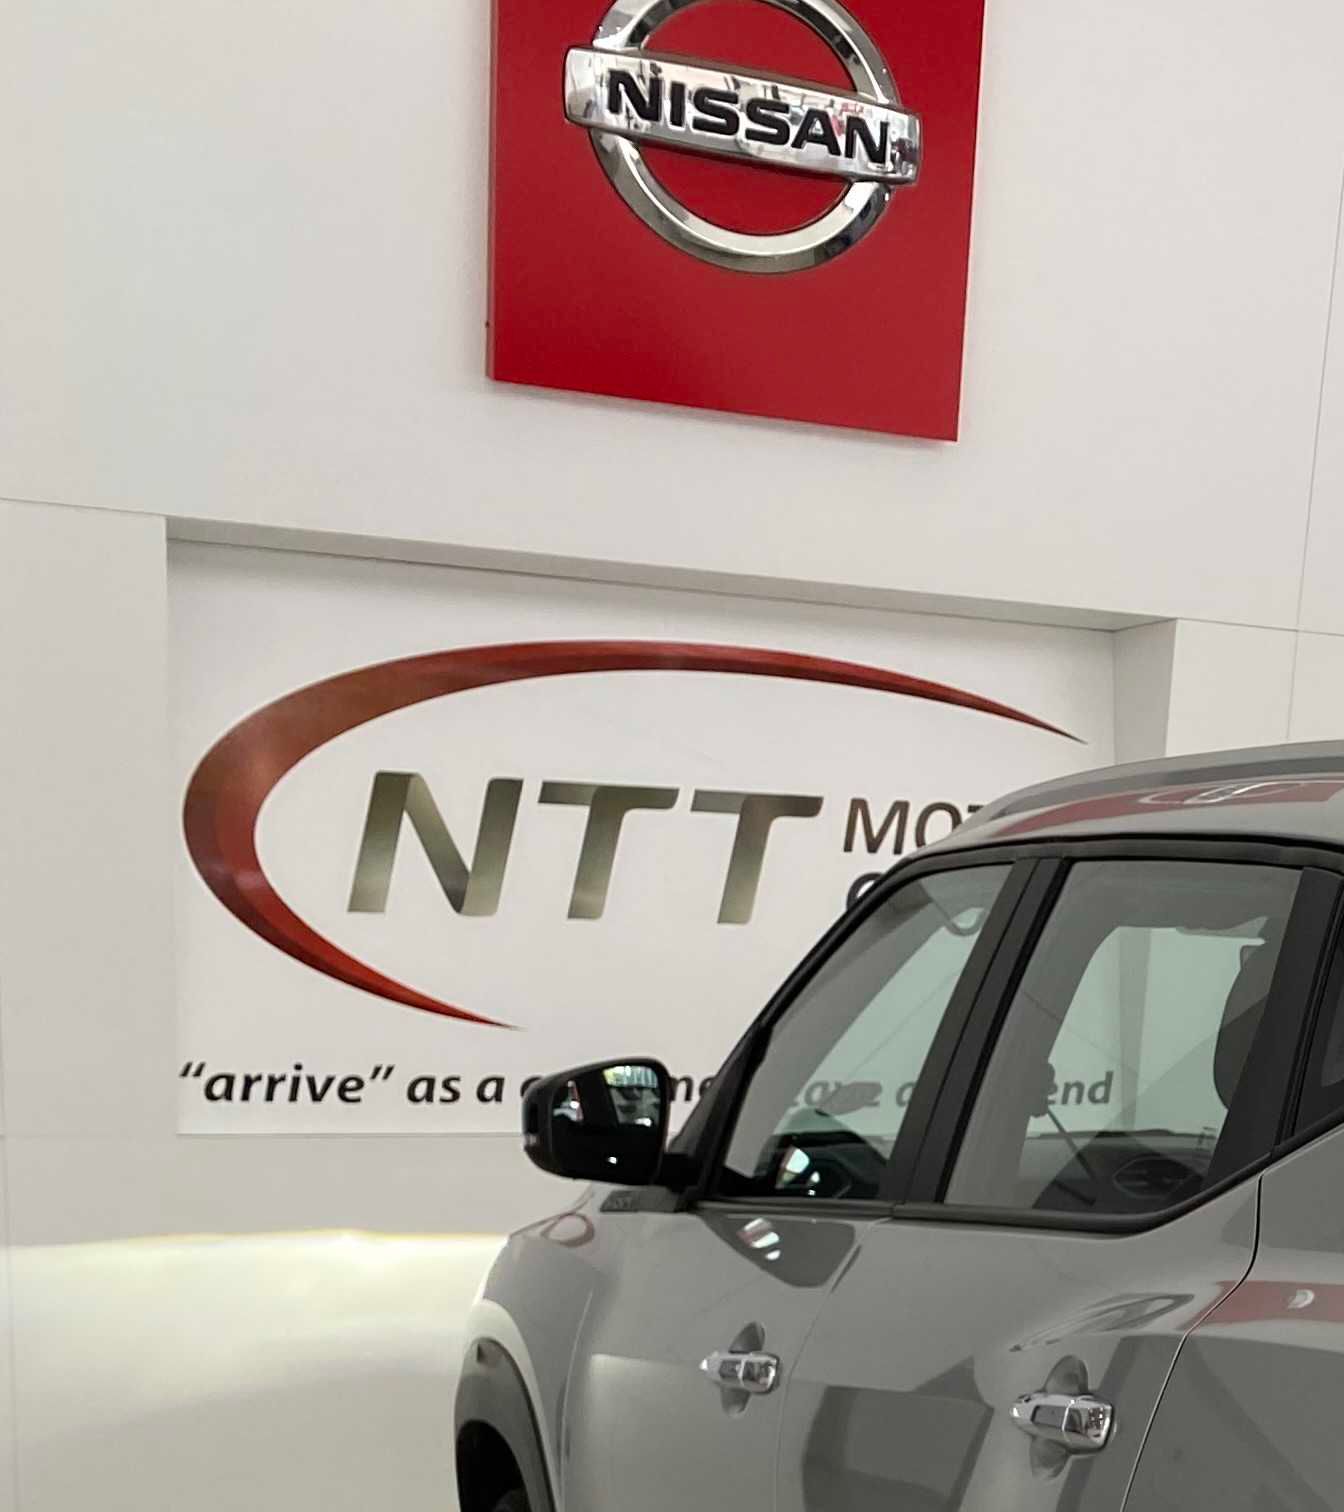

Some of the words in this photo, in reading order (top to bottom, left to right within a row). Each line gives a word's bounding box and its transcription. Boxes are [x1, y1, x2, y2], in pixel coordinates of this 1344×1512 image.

[607, 69, 890, 164] NISSAN
[347, 770, 824, 925] NTT
[407, 1075, 462, 1104] as
[475, 1075, 506, 1104] a
